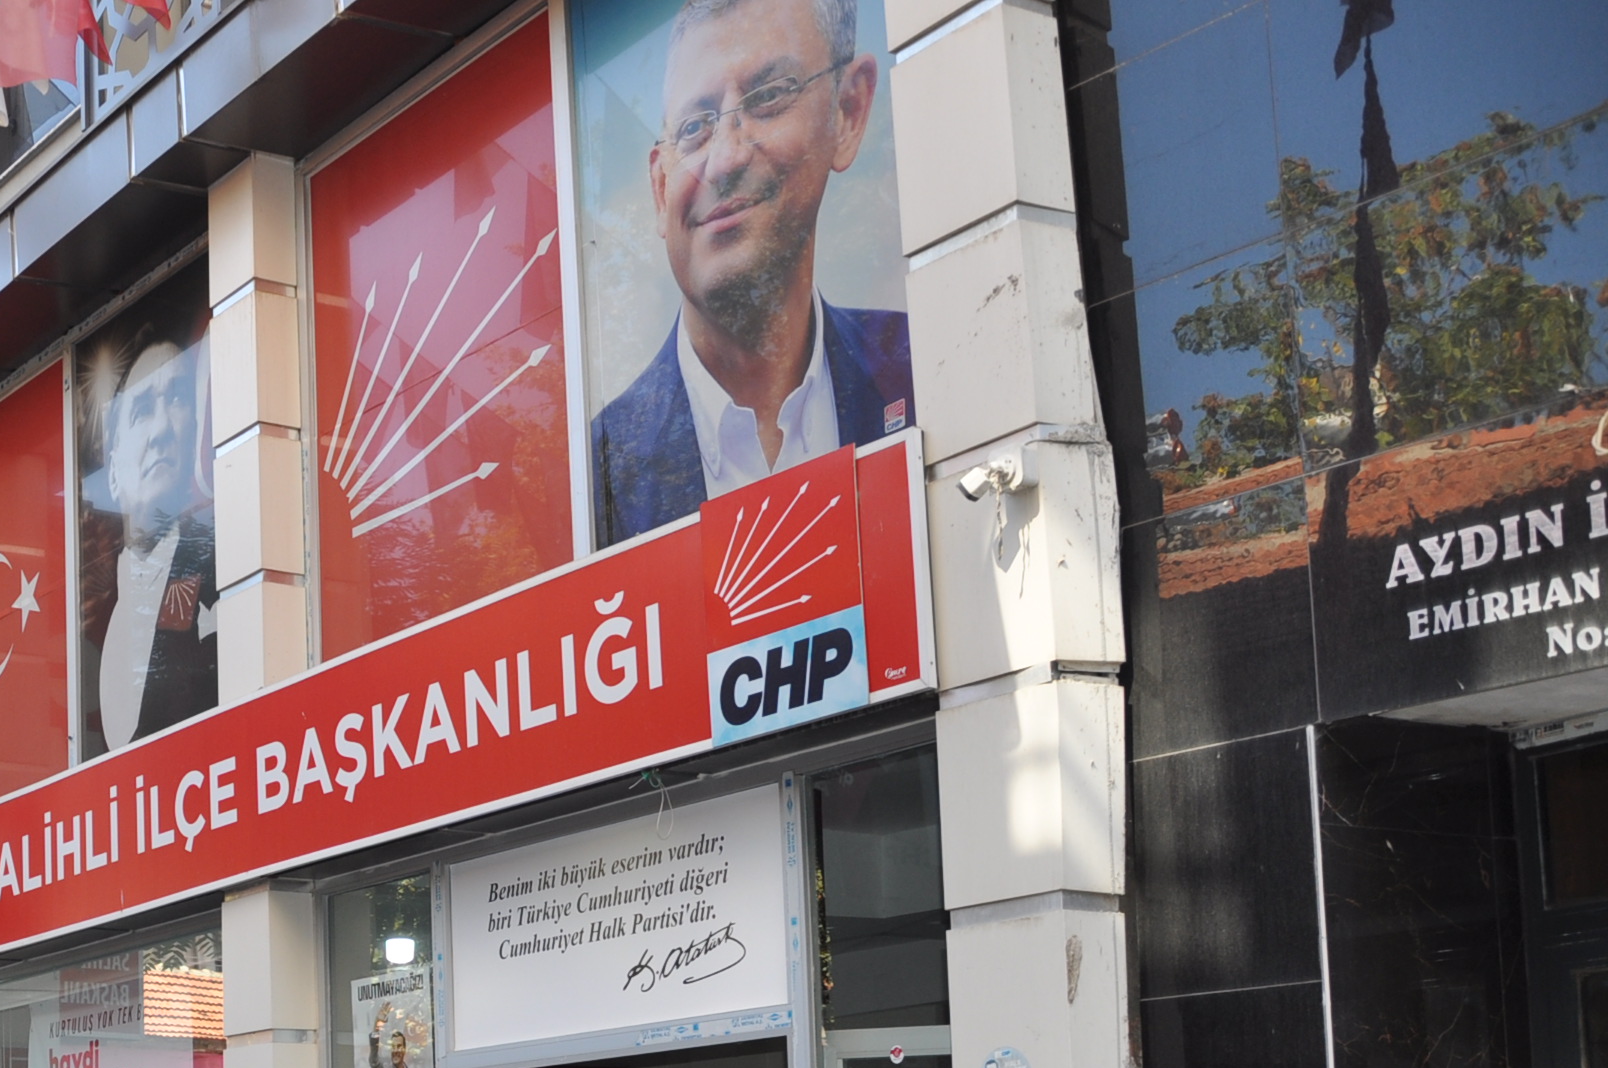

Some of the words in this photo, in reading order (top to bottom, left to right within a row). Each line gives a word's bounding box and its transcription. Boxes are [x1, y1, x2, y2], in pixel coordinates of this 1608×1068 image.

[1385, 503, 1565, 589] AYDIN
[1407, 567, 1601, 641] EMİRHAN
[719, 626, 854, 727] CHP
[135, 756, 239, 853] İLÇE
[256, 590, 665, 815] BAŞKANLIĞI
[488, 876, 533, 903] Benim
[538, 871, 556, 892] iki
[560, 857, 606, 889] büyük
[611, 847, 663, 876] eserim
[668, 833, 725, 862] vardır;
[488, 907, 512, 933] biri
[517, 898, 572, 927] Türkiye
[576, 874, 675, 914] Cumhuriyeti
[679, 862, 729, 895] diğeri
[498, 929, 585, 960] Cumhuriyet
[588, 916, 627, 943] Halk
[631, 900, 717, 935] Partisi'dir.
[49, 1013, 94, 1039] KURTULUŞ
[97, 1010, 113, 1030] YOK
[117, 1006, 134, 1024] TEK
